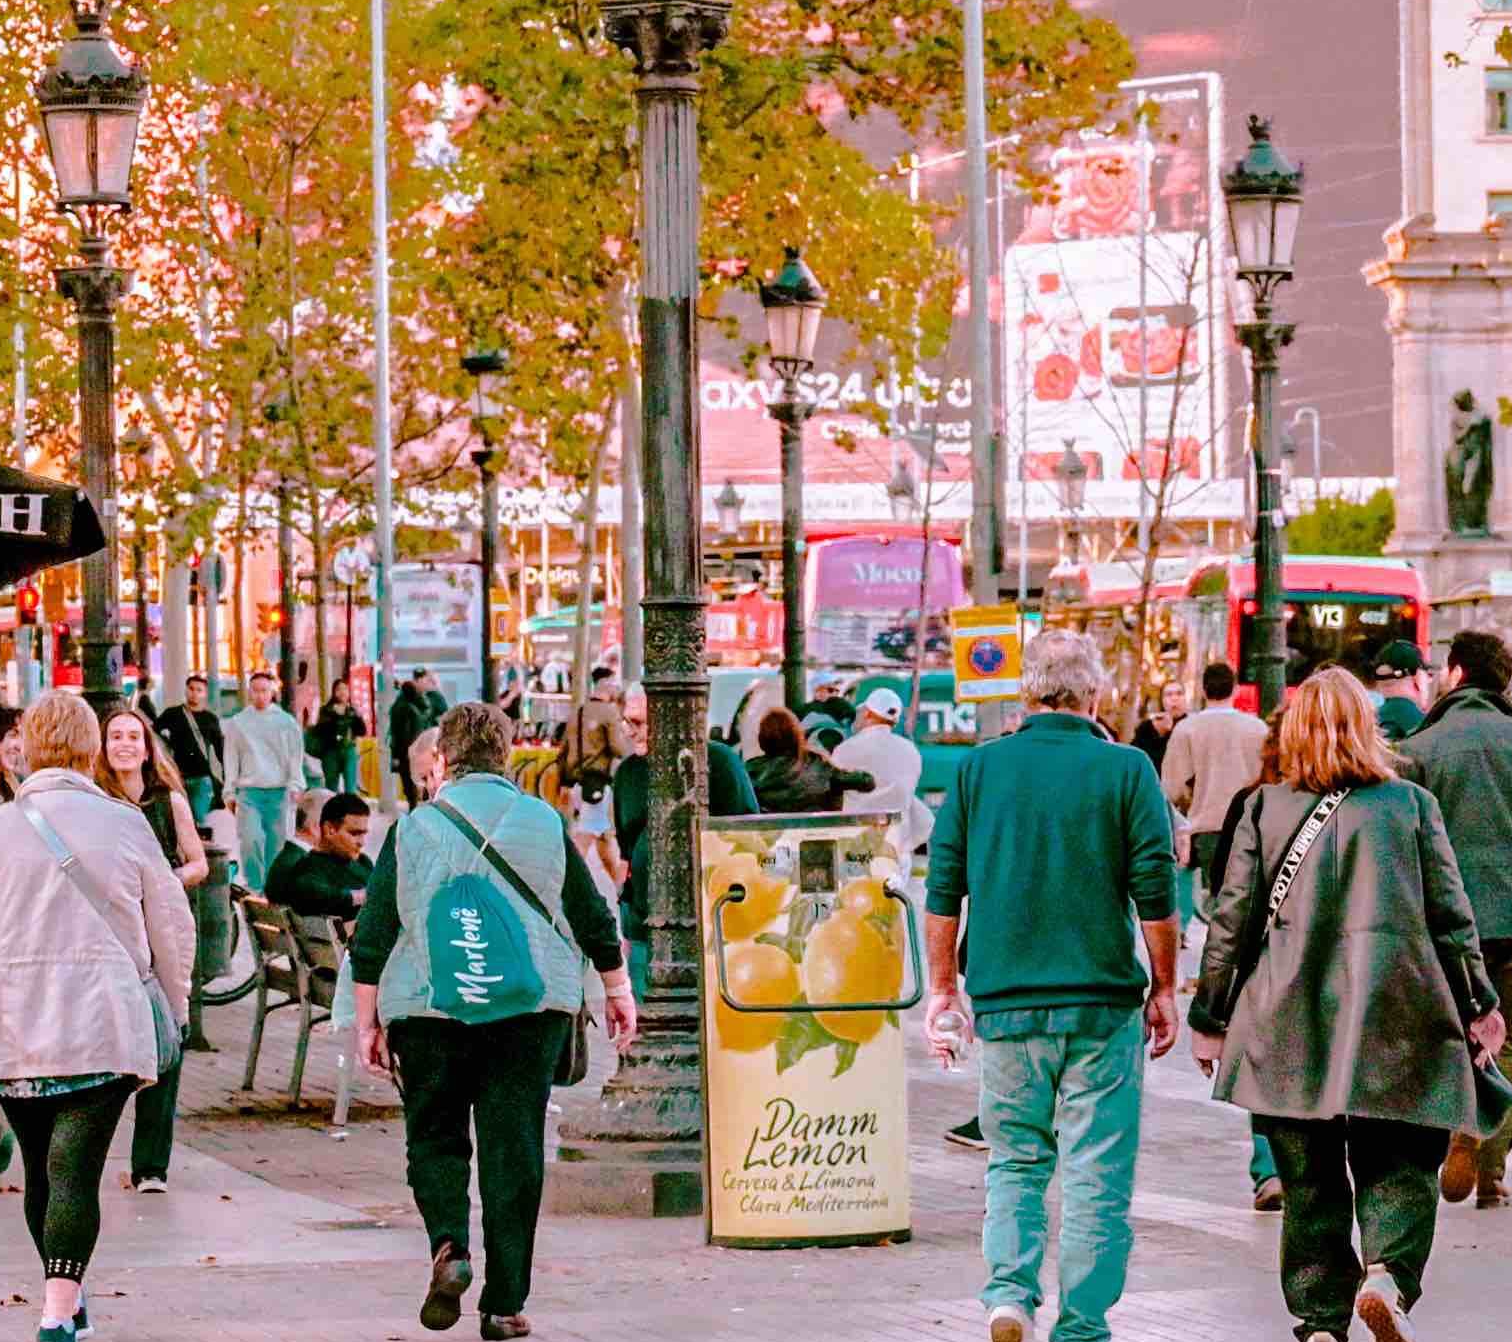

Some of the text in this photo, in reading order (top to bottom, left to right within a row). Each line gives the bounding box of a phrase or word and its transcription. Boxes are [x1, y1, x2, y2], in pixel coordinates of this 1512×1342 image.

[699, 379, 784, 418] axy
[759, 1097, 879, 1142] Damm
[743, 1126, 868, 1171] Lemon
[722, 1169, 778, 1191] Cervesa
[781, 1171, 795, 1192] &
[739, 1194, 781, 1214] Clara
